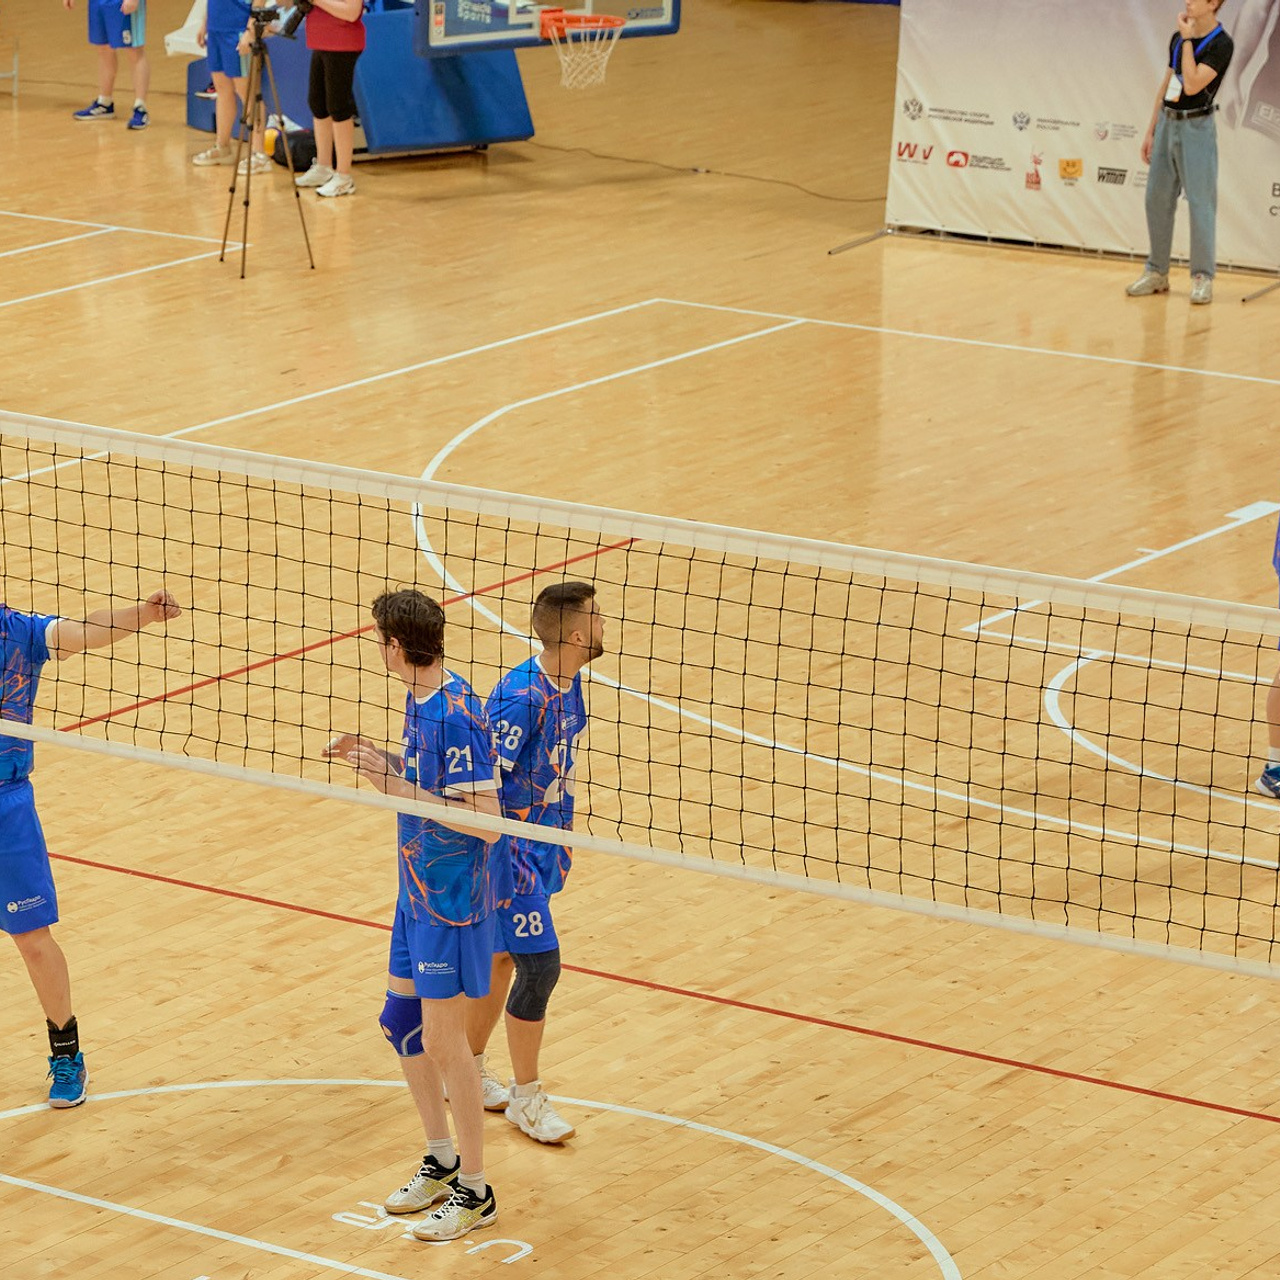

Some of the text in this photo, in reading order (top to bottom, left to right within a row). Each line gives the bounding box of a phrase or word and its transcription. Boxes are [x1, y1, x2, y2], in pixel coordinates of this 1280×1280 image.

[493, 719, 523, 751] 28
[446, 744, 474, 774] 21
[512, 911, 544, 938] 28
